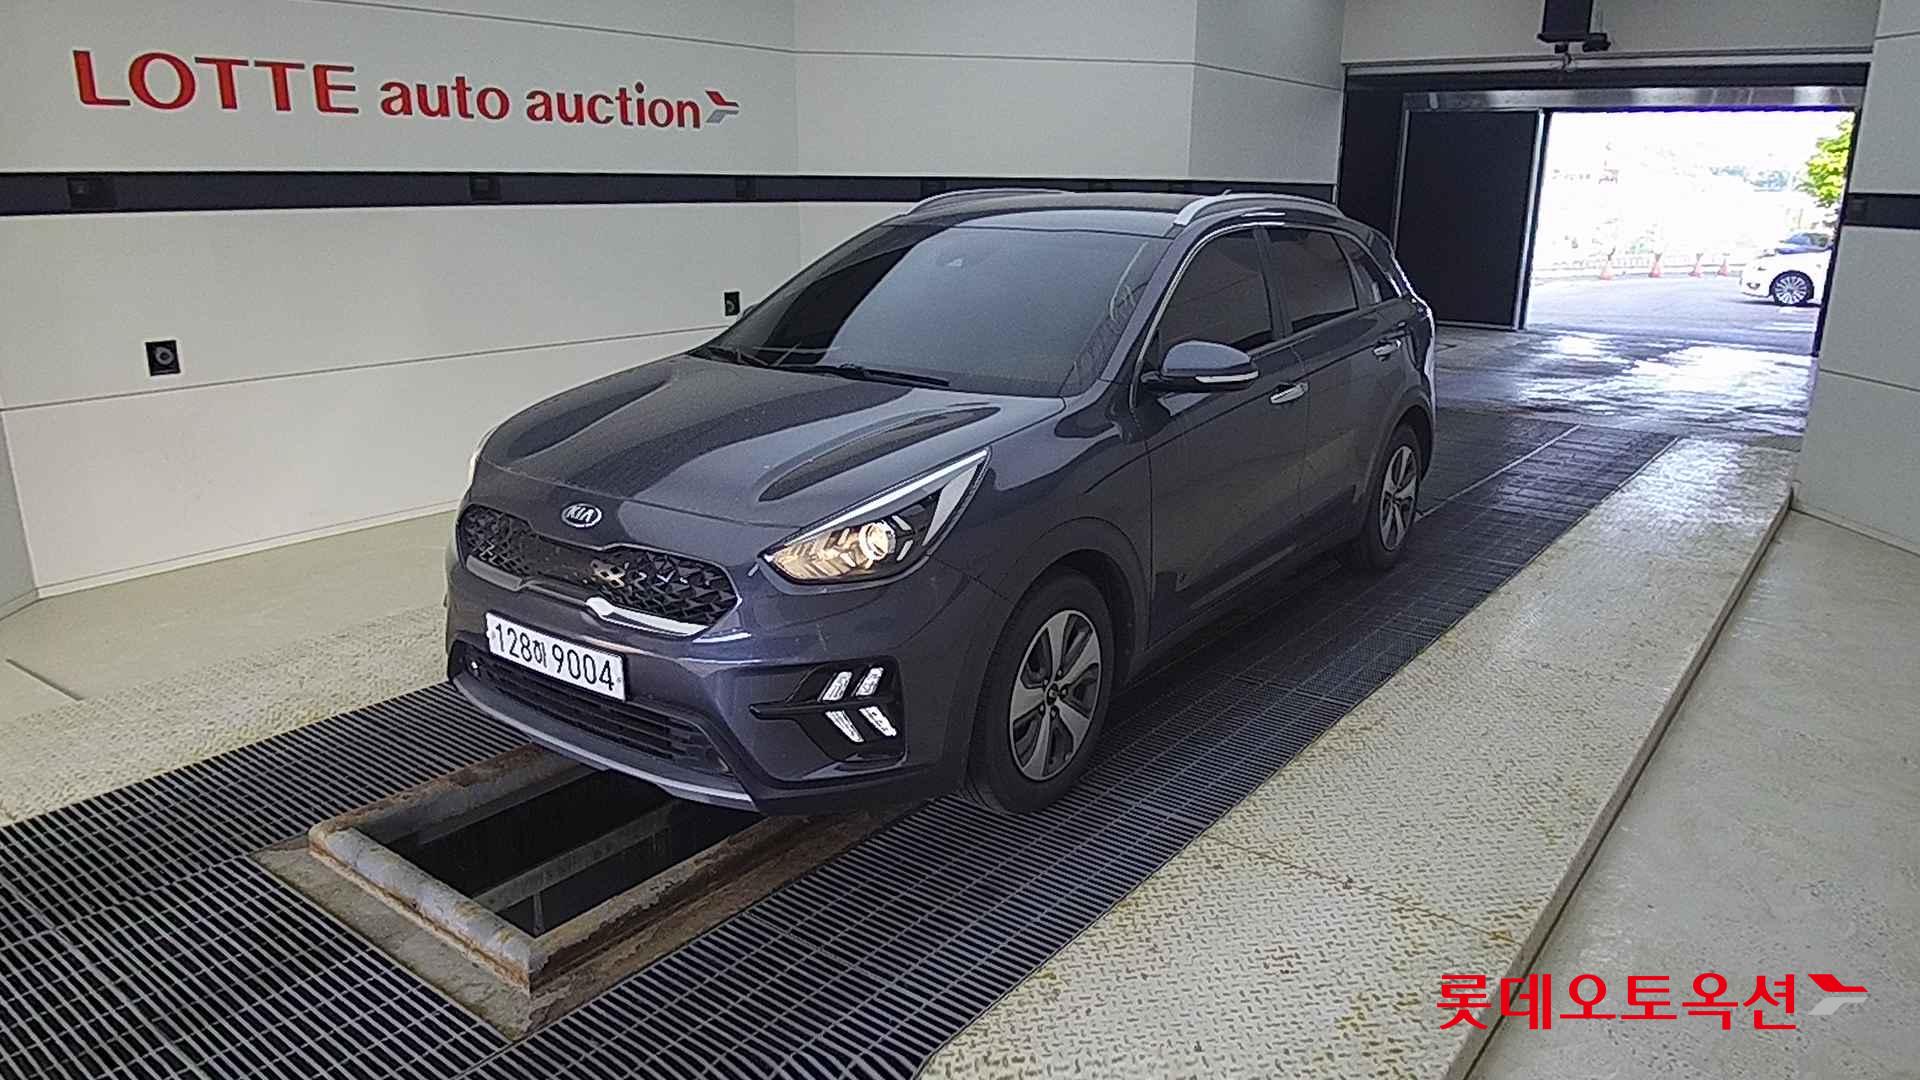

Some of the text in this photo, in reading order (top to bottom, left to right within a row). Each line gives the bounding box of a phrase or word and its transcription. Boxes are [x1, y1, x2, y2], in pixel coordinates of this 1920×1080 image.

[72, 50, 701, 129] LOTTE auto auction
[566, 505, 595, 522] KIA
